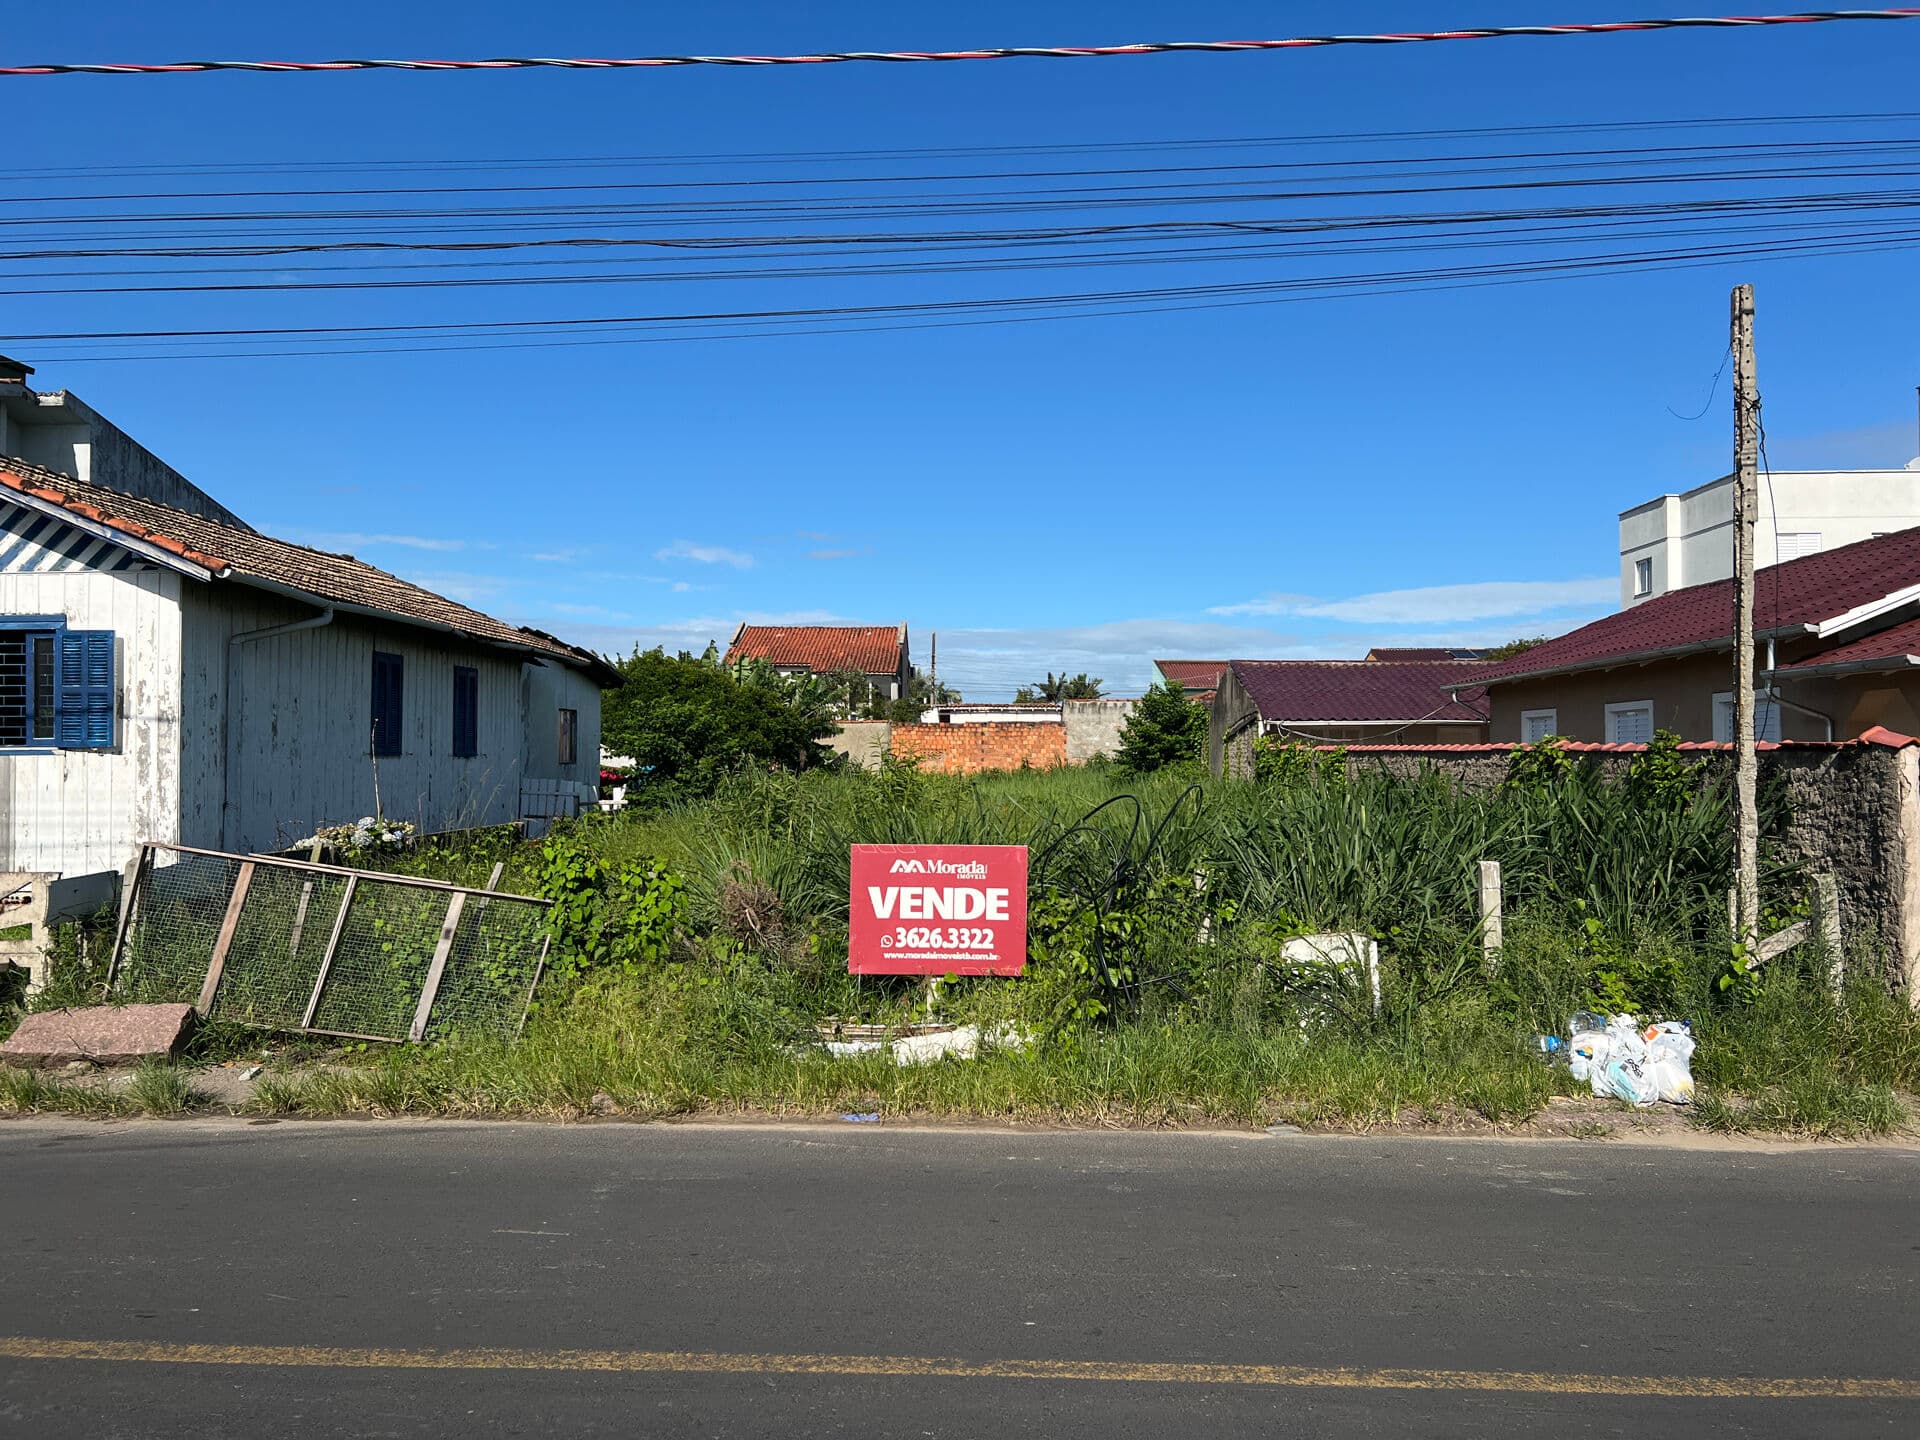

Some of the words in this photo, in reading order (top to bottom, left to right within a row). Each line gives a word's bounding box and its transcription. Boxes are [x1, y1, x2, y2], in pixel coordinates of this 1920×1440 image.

[926, 859, 984, 873] Morada
[867, 886, 1010, 921] VENDE
[895, 927, 994, 949] 3626.3322
